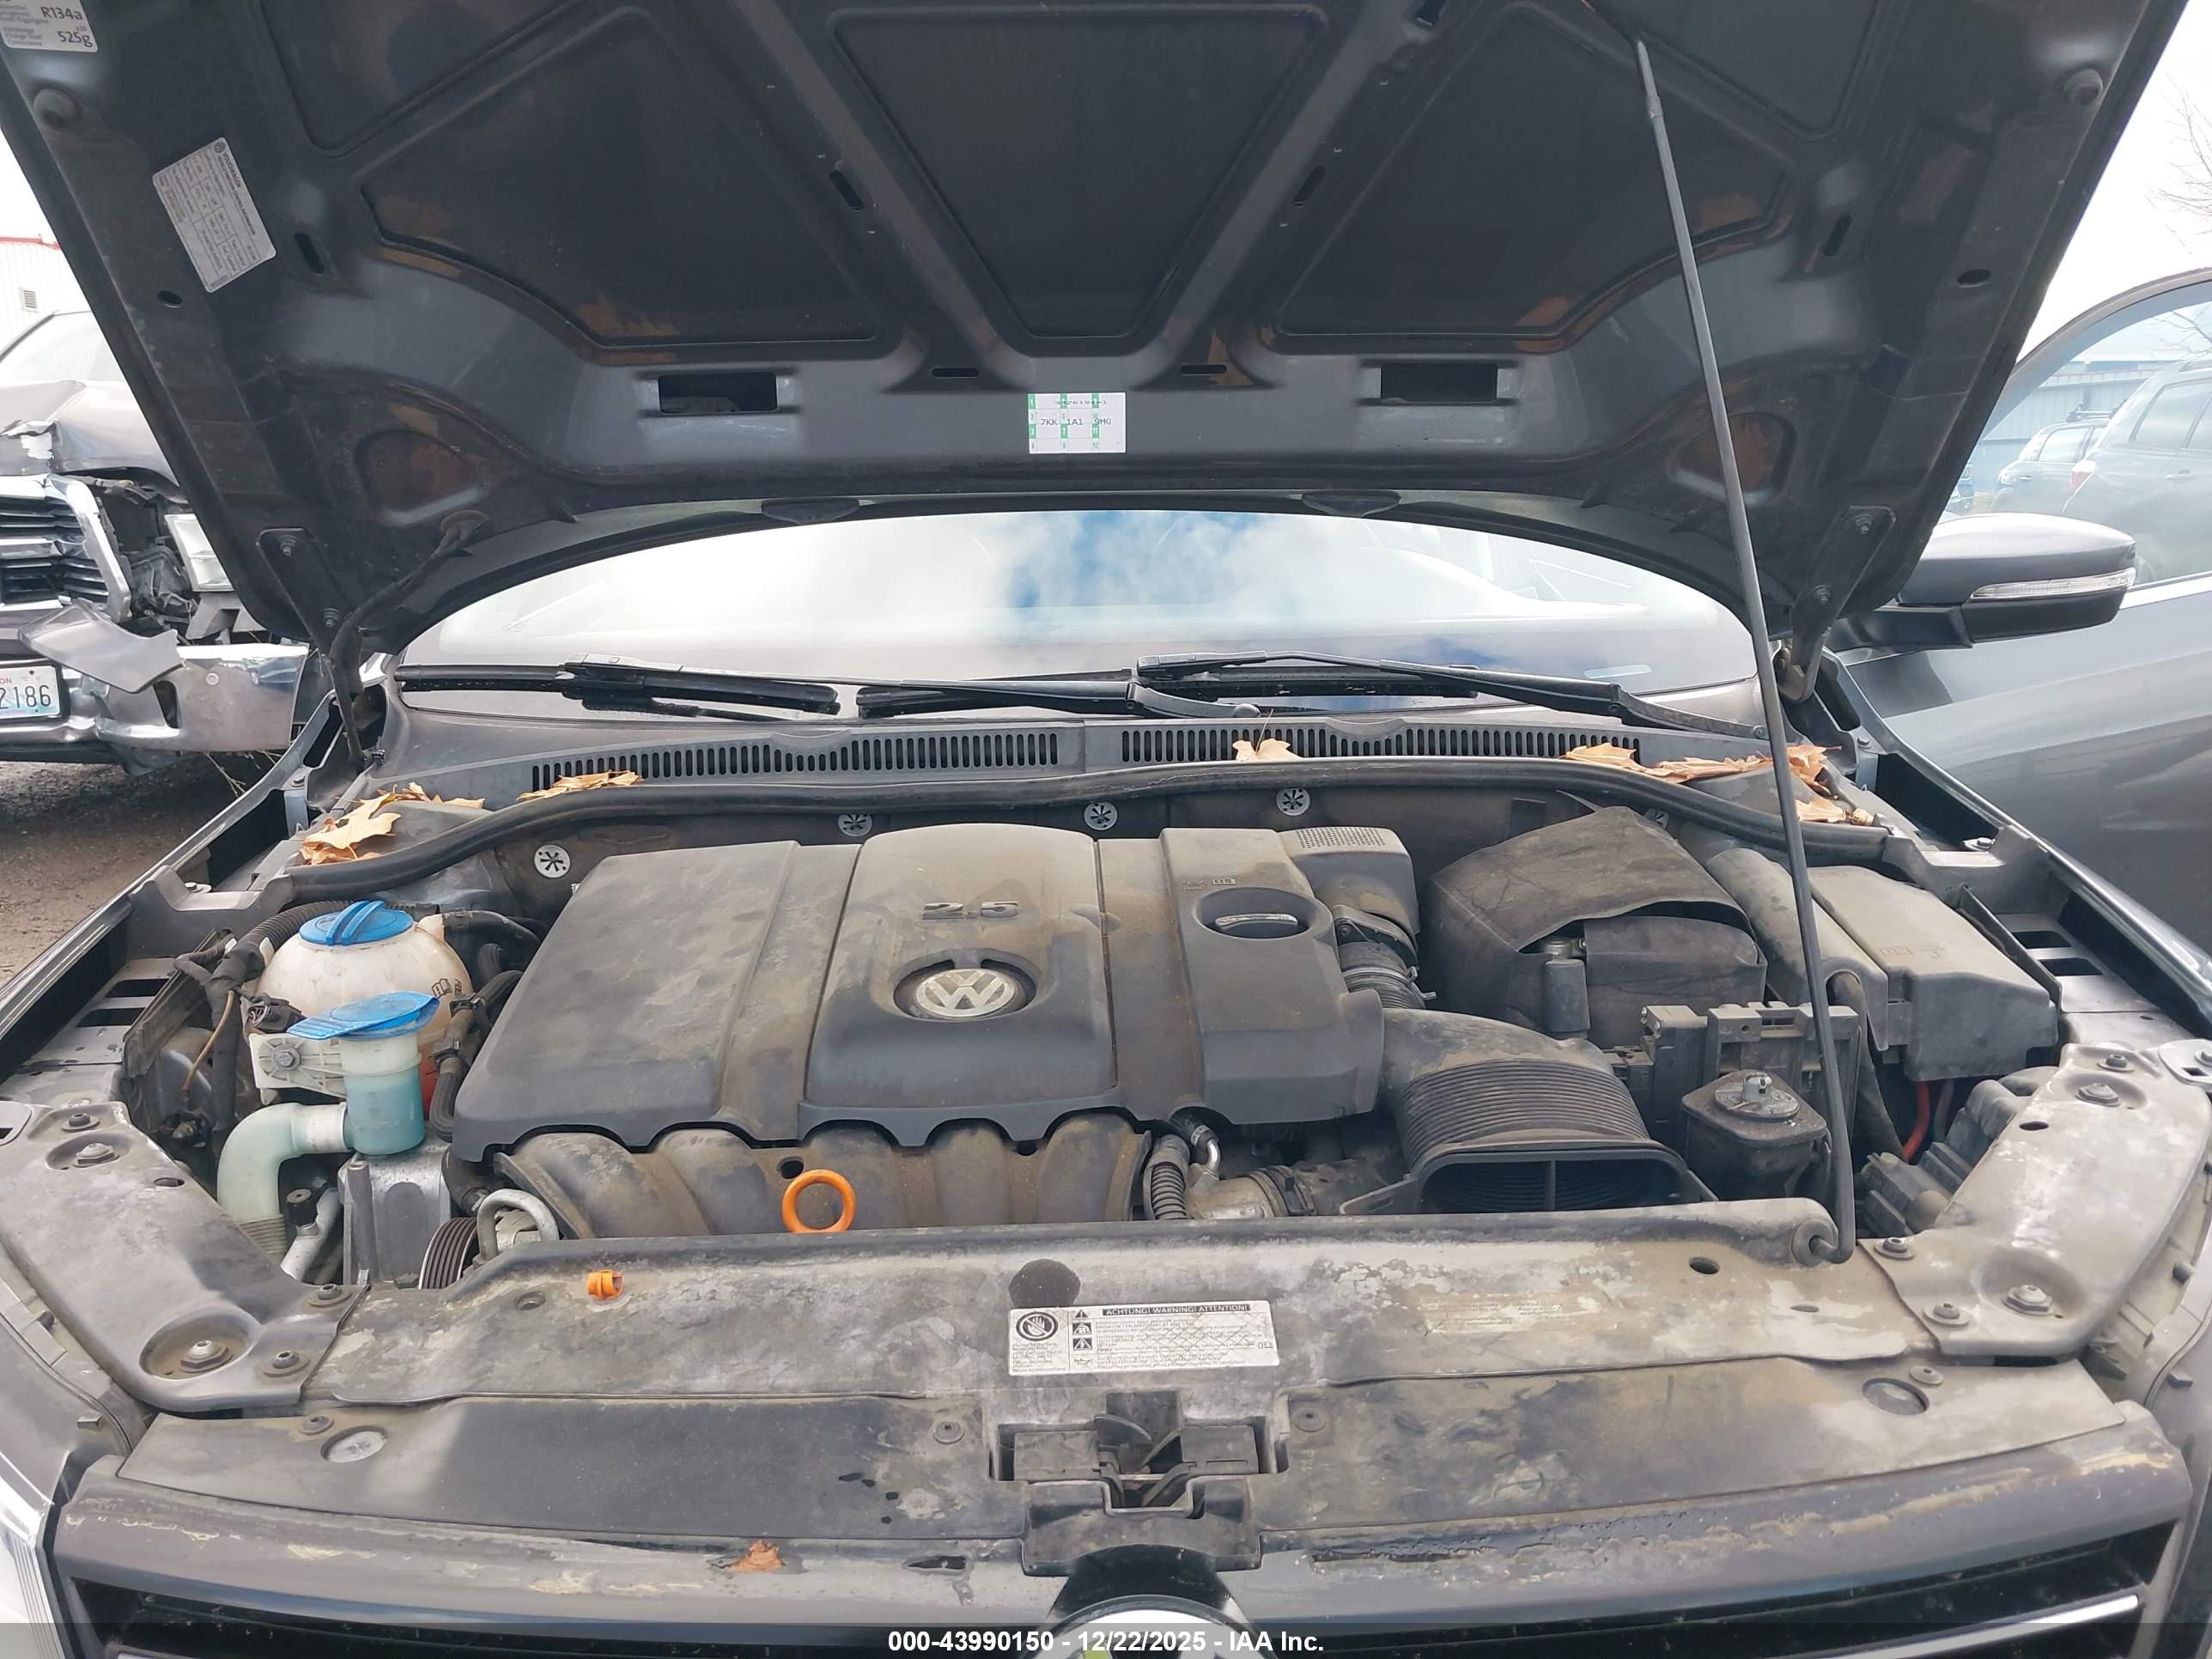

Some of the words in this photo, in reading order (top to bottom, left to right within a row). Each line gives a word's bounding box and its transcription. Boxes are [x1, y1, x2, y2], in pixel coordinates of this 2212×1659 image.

[40, 6, 83, 21] R134a
[58, 31, 93, 48] 525g
[0, 684, 52, 708] 2186
[921, 902, 1020, 921] 2.5
[1152, 1306, 1197, 1315] WARNING!
[1198, 1304, 1248, 1313] ATTENTION!
